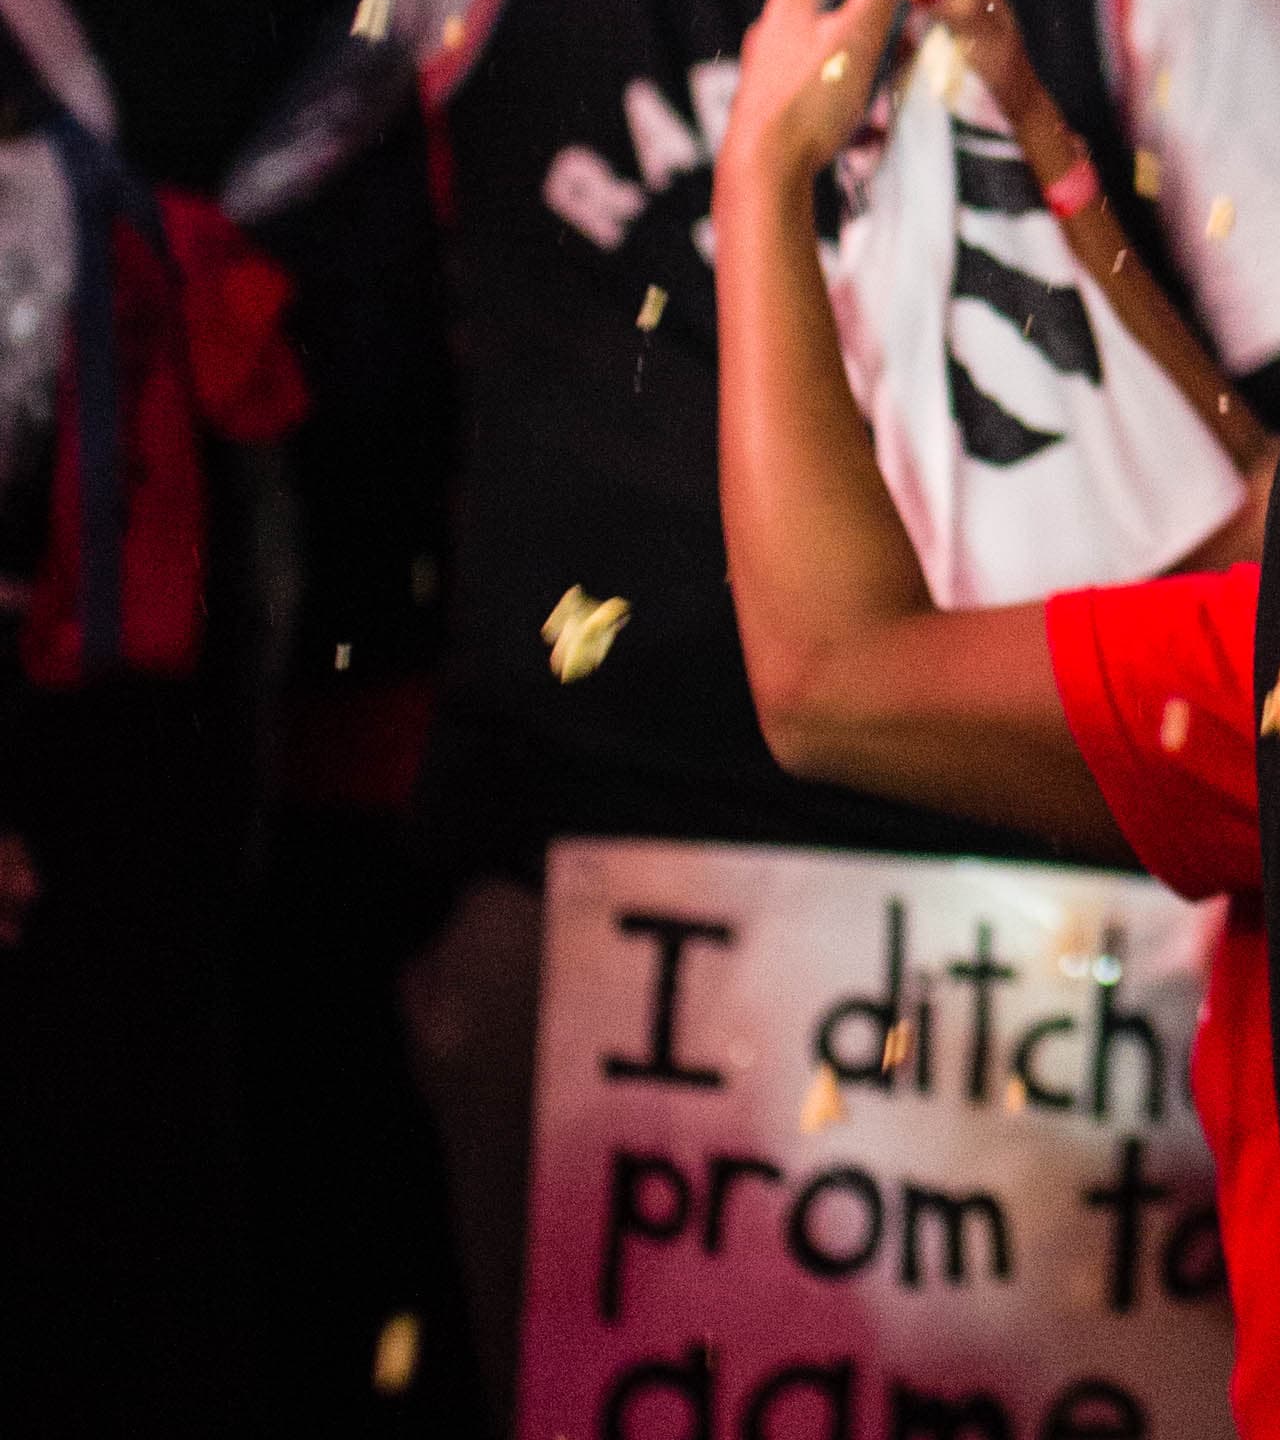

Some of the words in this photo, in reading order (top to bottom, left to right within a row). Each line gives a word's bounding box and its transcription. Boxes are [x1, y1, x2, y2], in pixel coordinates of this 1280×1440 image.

[600, 910, 736, 1088] I
[812, 896, 1193, 1124] ditch
[596, 1148, 1014, 1328] prom
